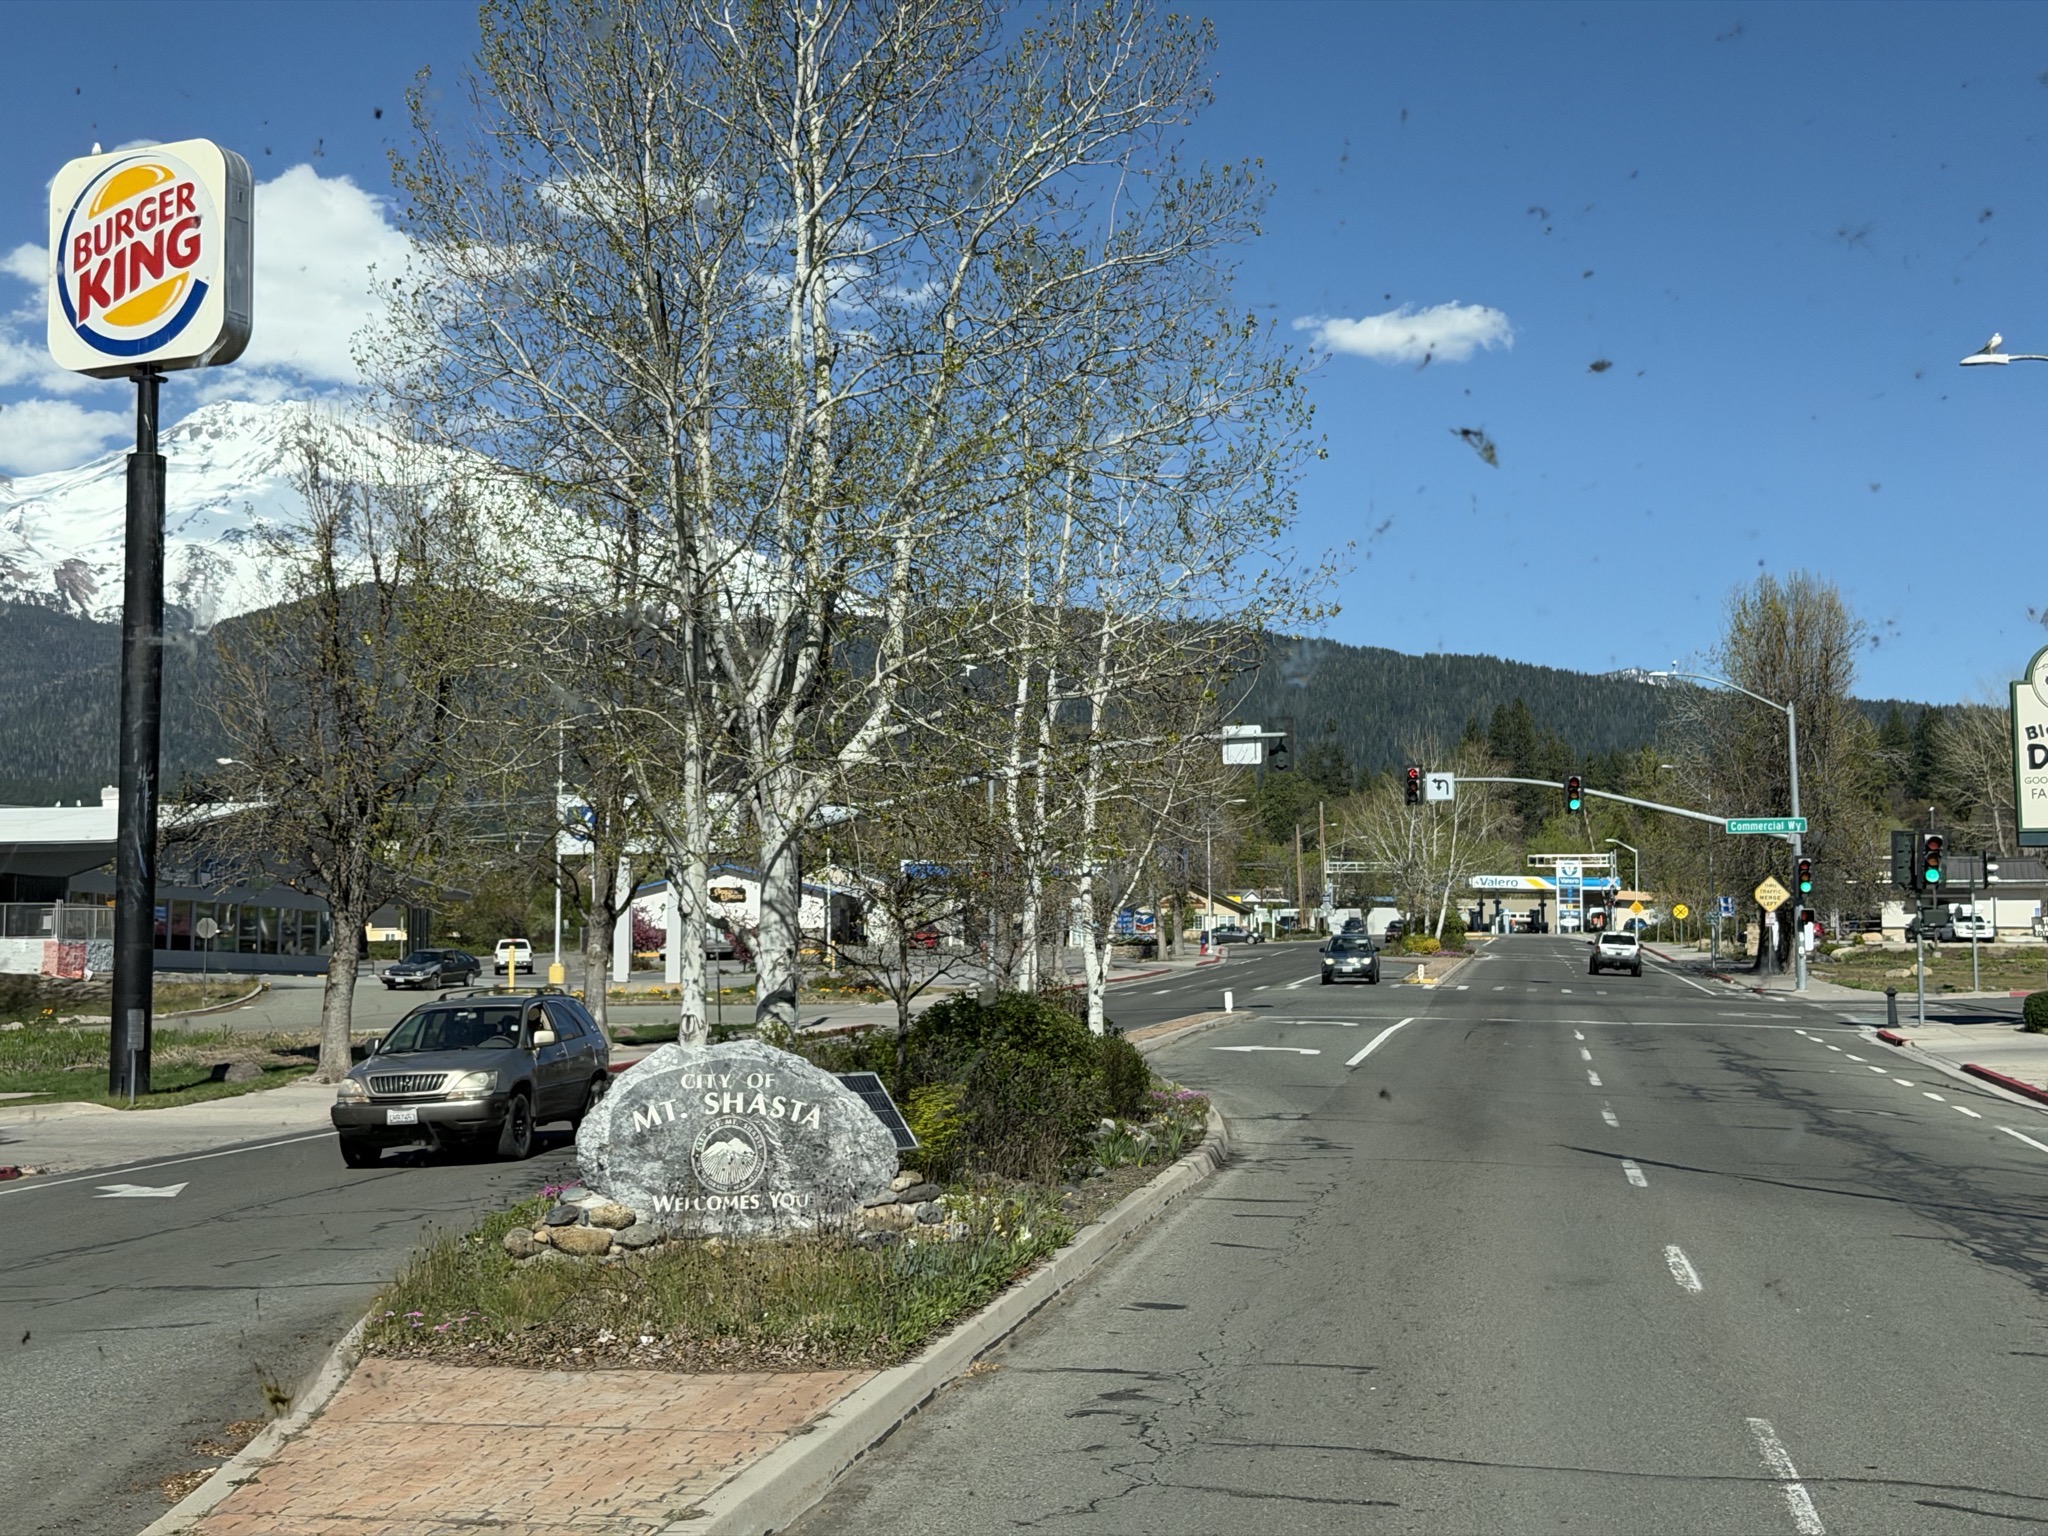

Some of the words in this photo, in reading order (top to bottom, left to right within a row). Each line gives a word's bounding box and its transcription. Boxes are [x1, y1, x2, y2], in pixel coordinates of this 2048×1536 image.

[74, 182, 195, 274] BURGER
[78, 216, 201, 323] KING
[2025, 723, 2048, 740] Bl
[1730, 821, 1784, 831] Commercial
[1788, 820, 1802, 831] Wy
[1480, 877, 1519, 887] Valero
[681, 1073, 731, 1089] CITY
[747, 1073, 775, 1088] OF
[633, 1099, 688, 1133] MT.
[704, 1091, 821, 1130] SHASTA
[743, 1122, 764, 1150] SHASTA
[652, 1194, 760, 1212] WELCOMES
[768, 1191, 809, 1209] YOU
